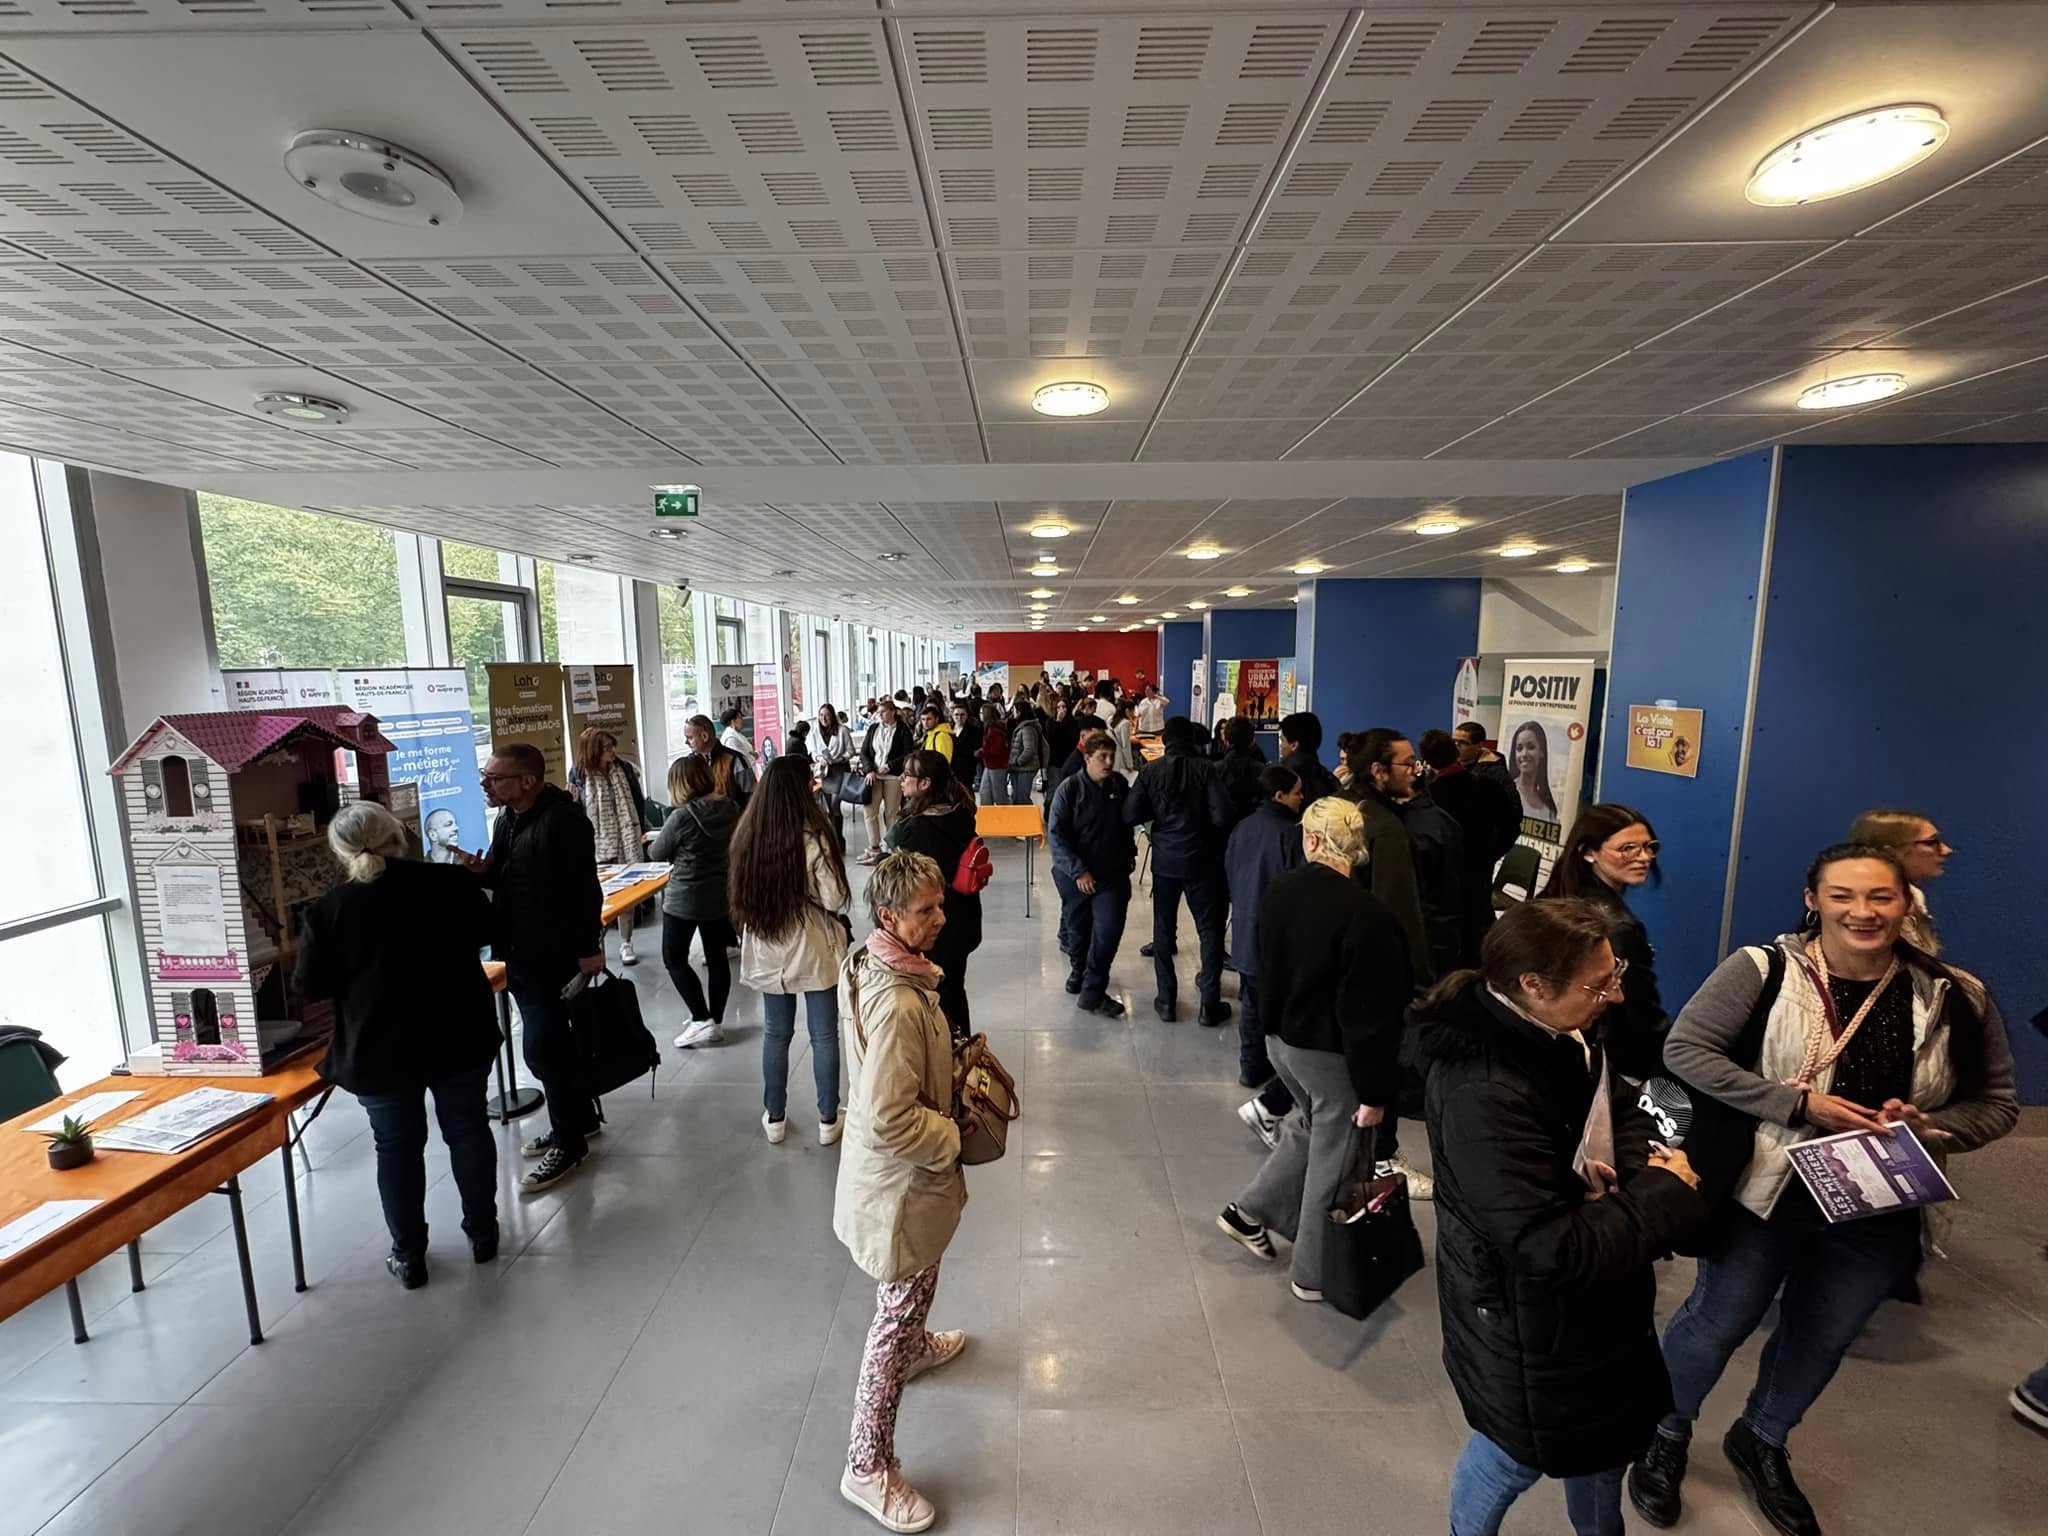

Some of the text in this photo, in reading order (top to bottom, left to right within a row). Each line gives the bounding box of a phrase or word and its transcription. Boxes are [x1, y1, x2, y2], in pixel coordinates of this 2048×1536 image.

[1248, 672, 1276, 681] URBAN
[1248, 680, 1270, 689] TRAIL
[1509, 675, 1581, 702] POSITIV
[495, 703, 553, 717] Nos formations
[496, 718, 508, 727] en
[1636, 711, 1674, 727] La Visite
[496, 726, 509, 736] du
[509, 722, 526, 734] CAP
[395, 750, 406, 760] Je
[424, 746, 452, 756] forme
[403, 756, 450, 771] métiers
[1802, 1147, 1853, 1214] LES MÉTIERS
